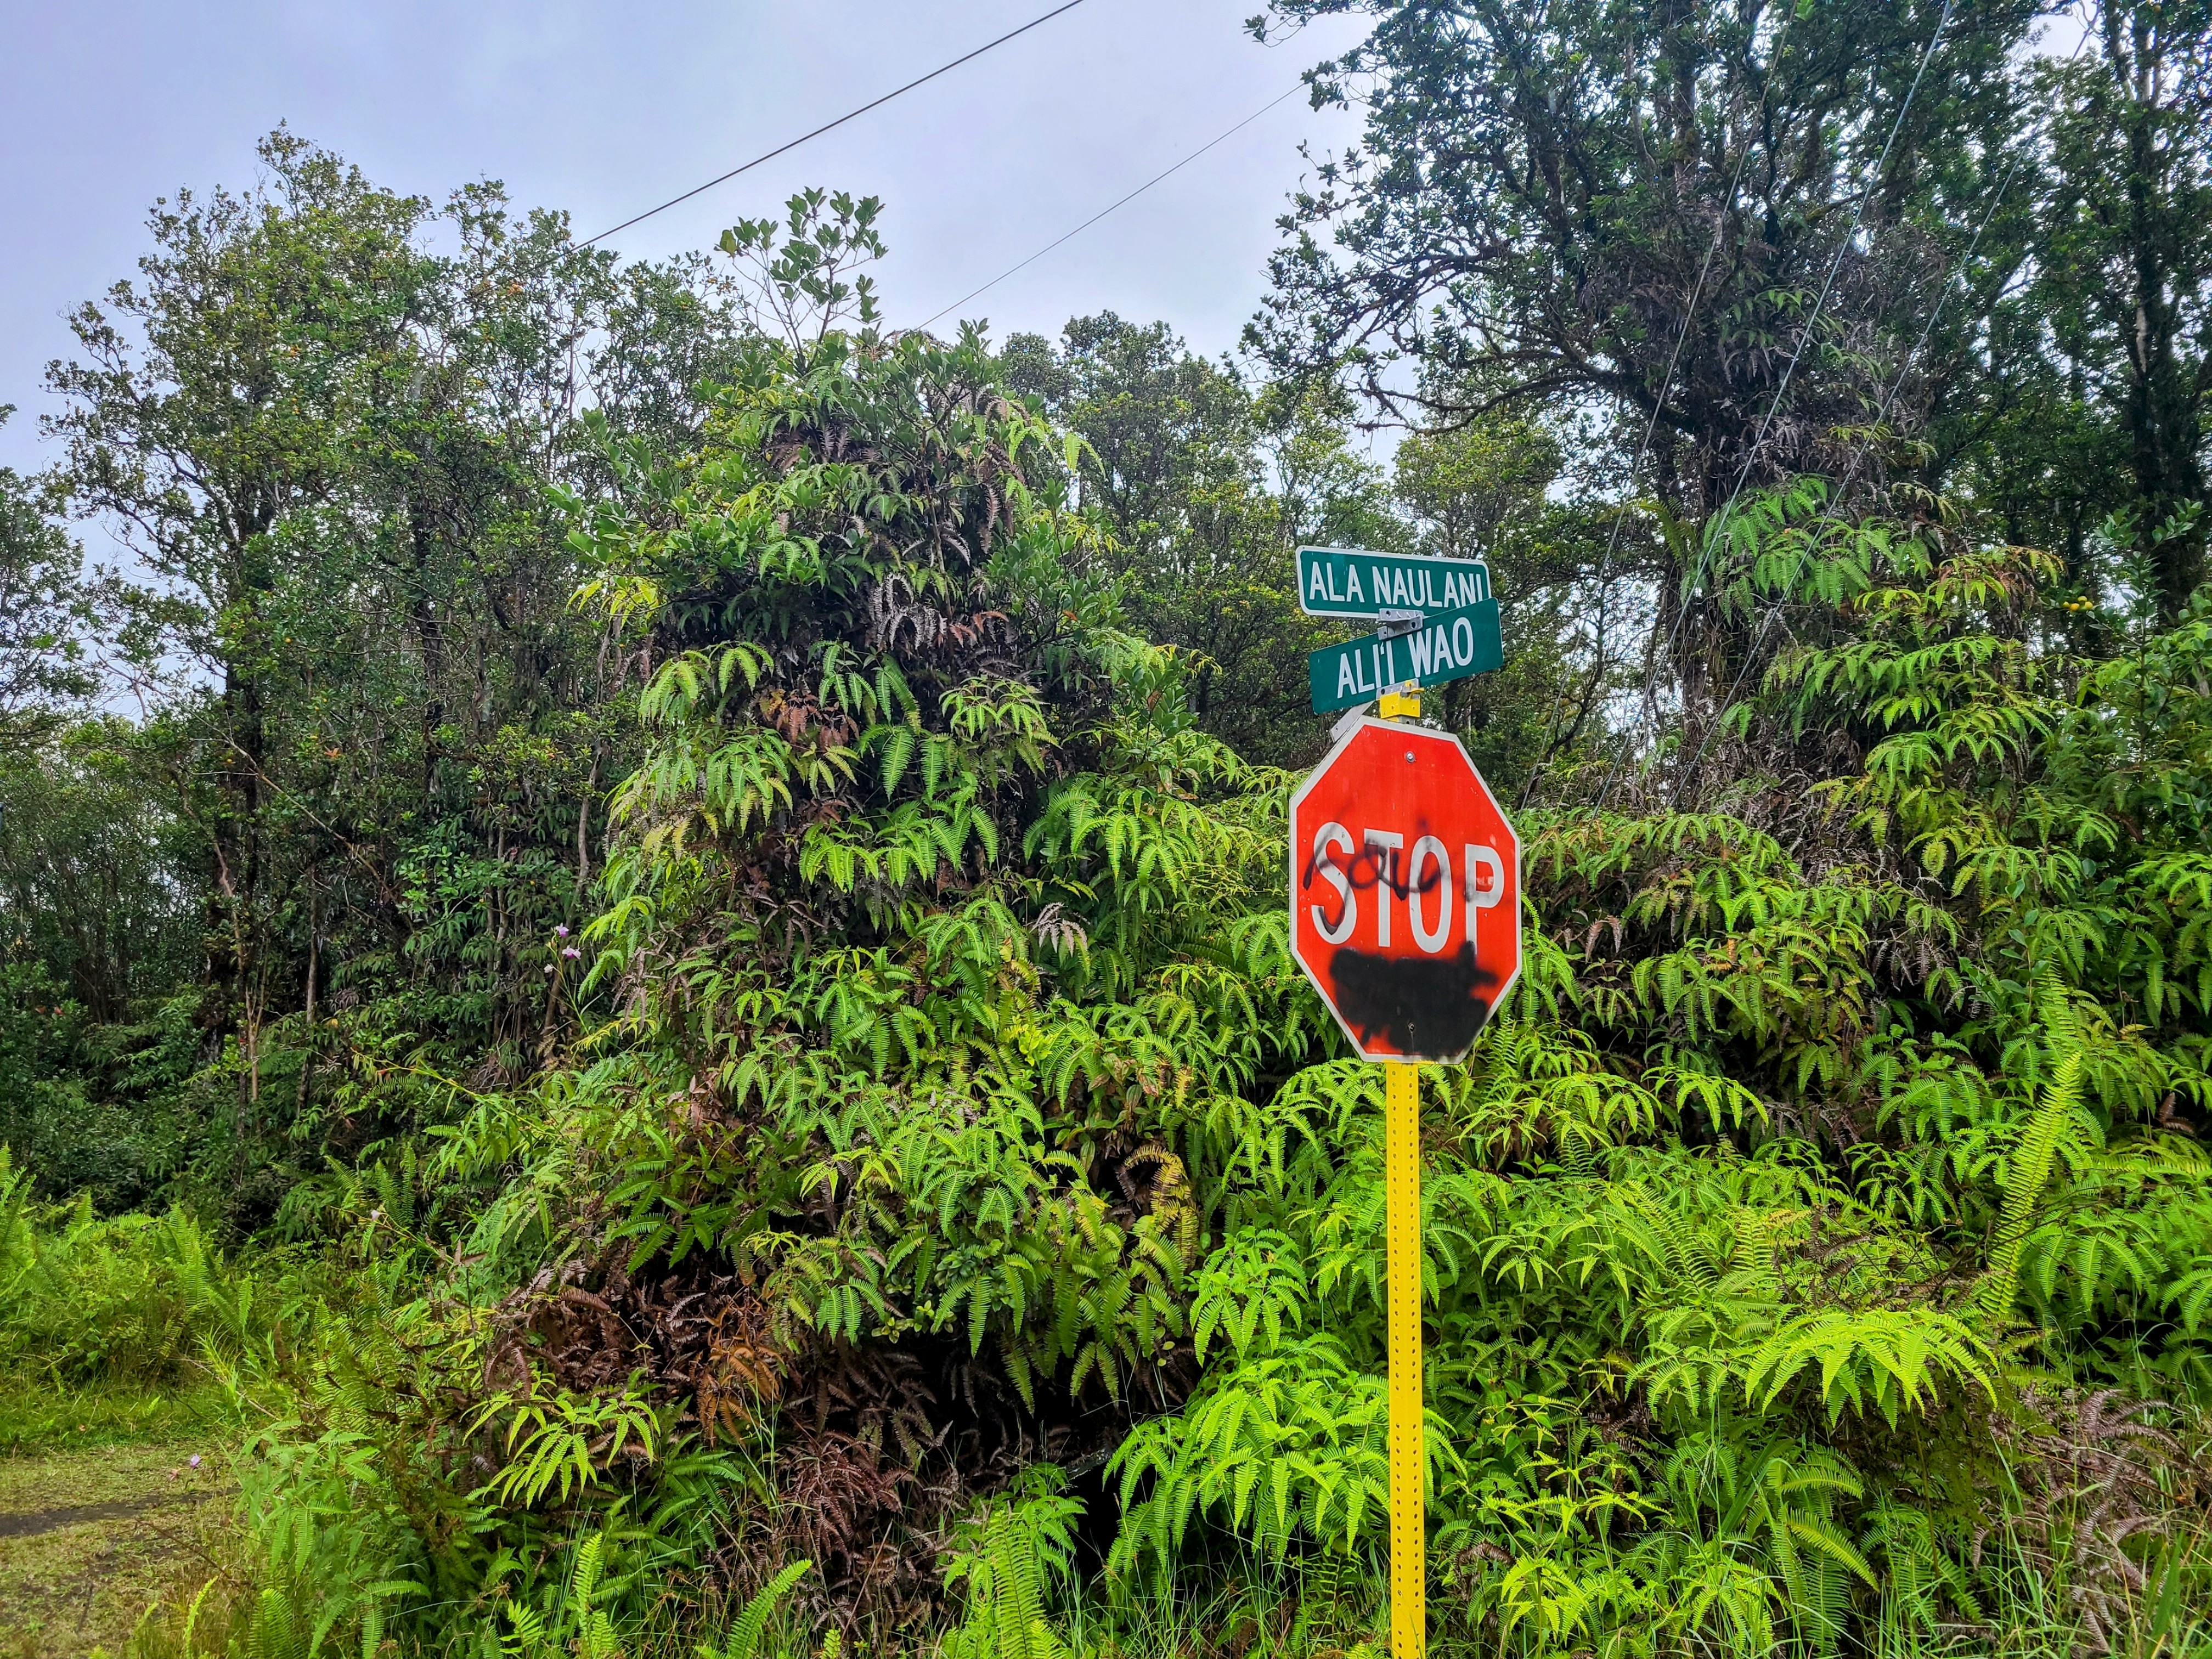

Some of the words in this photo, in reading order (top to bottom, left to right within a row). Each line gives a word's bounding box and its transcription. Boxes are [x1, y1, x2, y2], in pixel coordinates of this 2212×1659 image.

[1310, 562, 1365, 603] ALA
[1372, 566, 1482, 608] NAULANI
[1407, 617, 1474, 678] WAO
[1311, 822, 1504, 955] STOP
